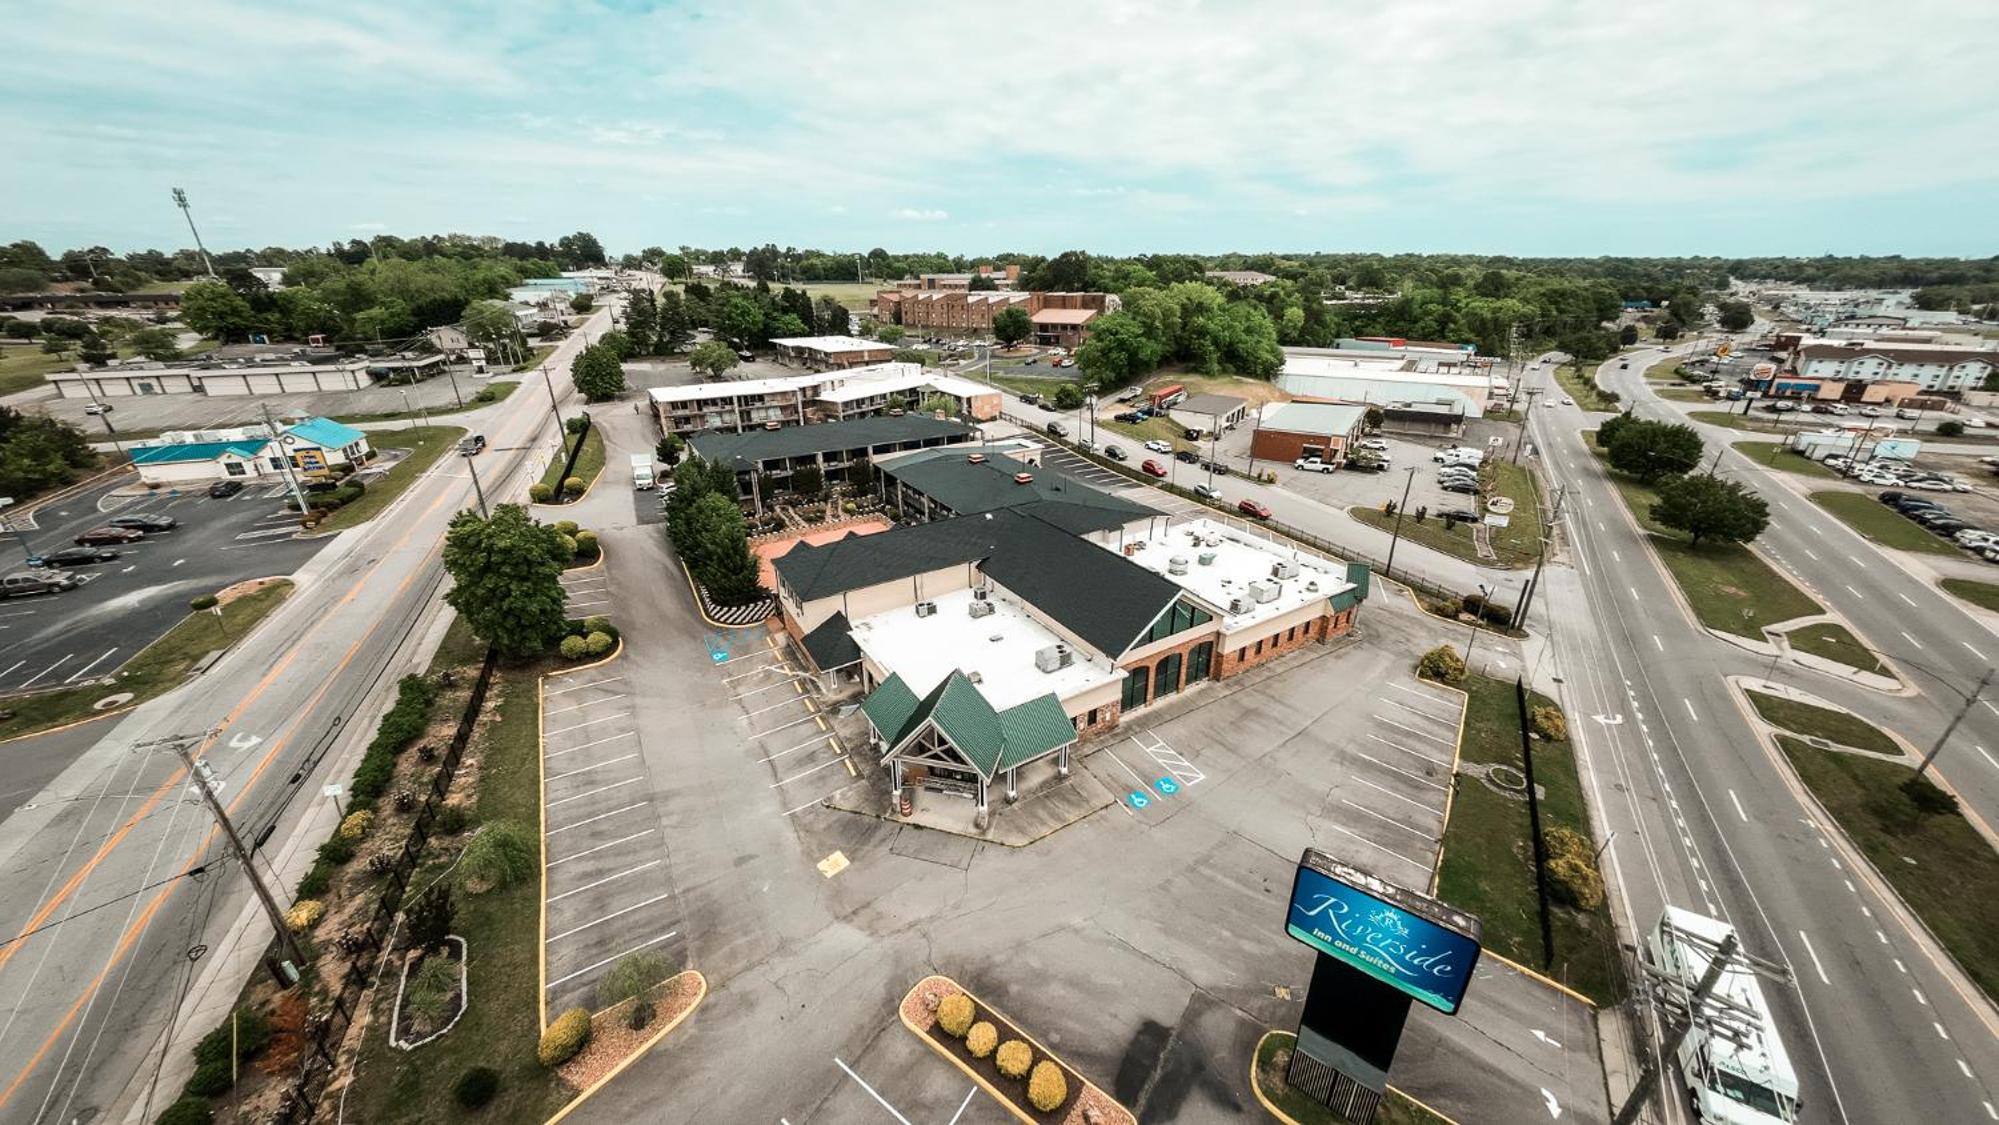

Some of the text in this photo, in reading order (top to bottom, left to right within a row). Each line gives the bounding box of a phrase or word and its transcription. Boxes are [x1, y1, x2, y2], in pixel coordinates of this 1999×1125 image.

[1294, 894, 1454, 978] Riverside
[1313, 928, 1396, 973] Inn and Suites
